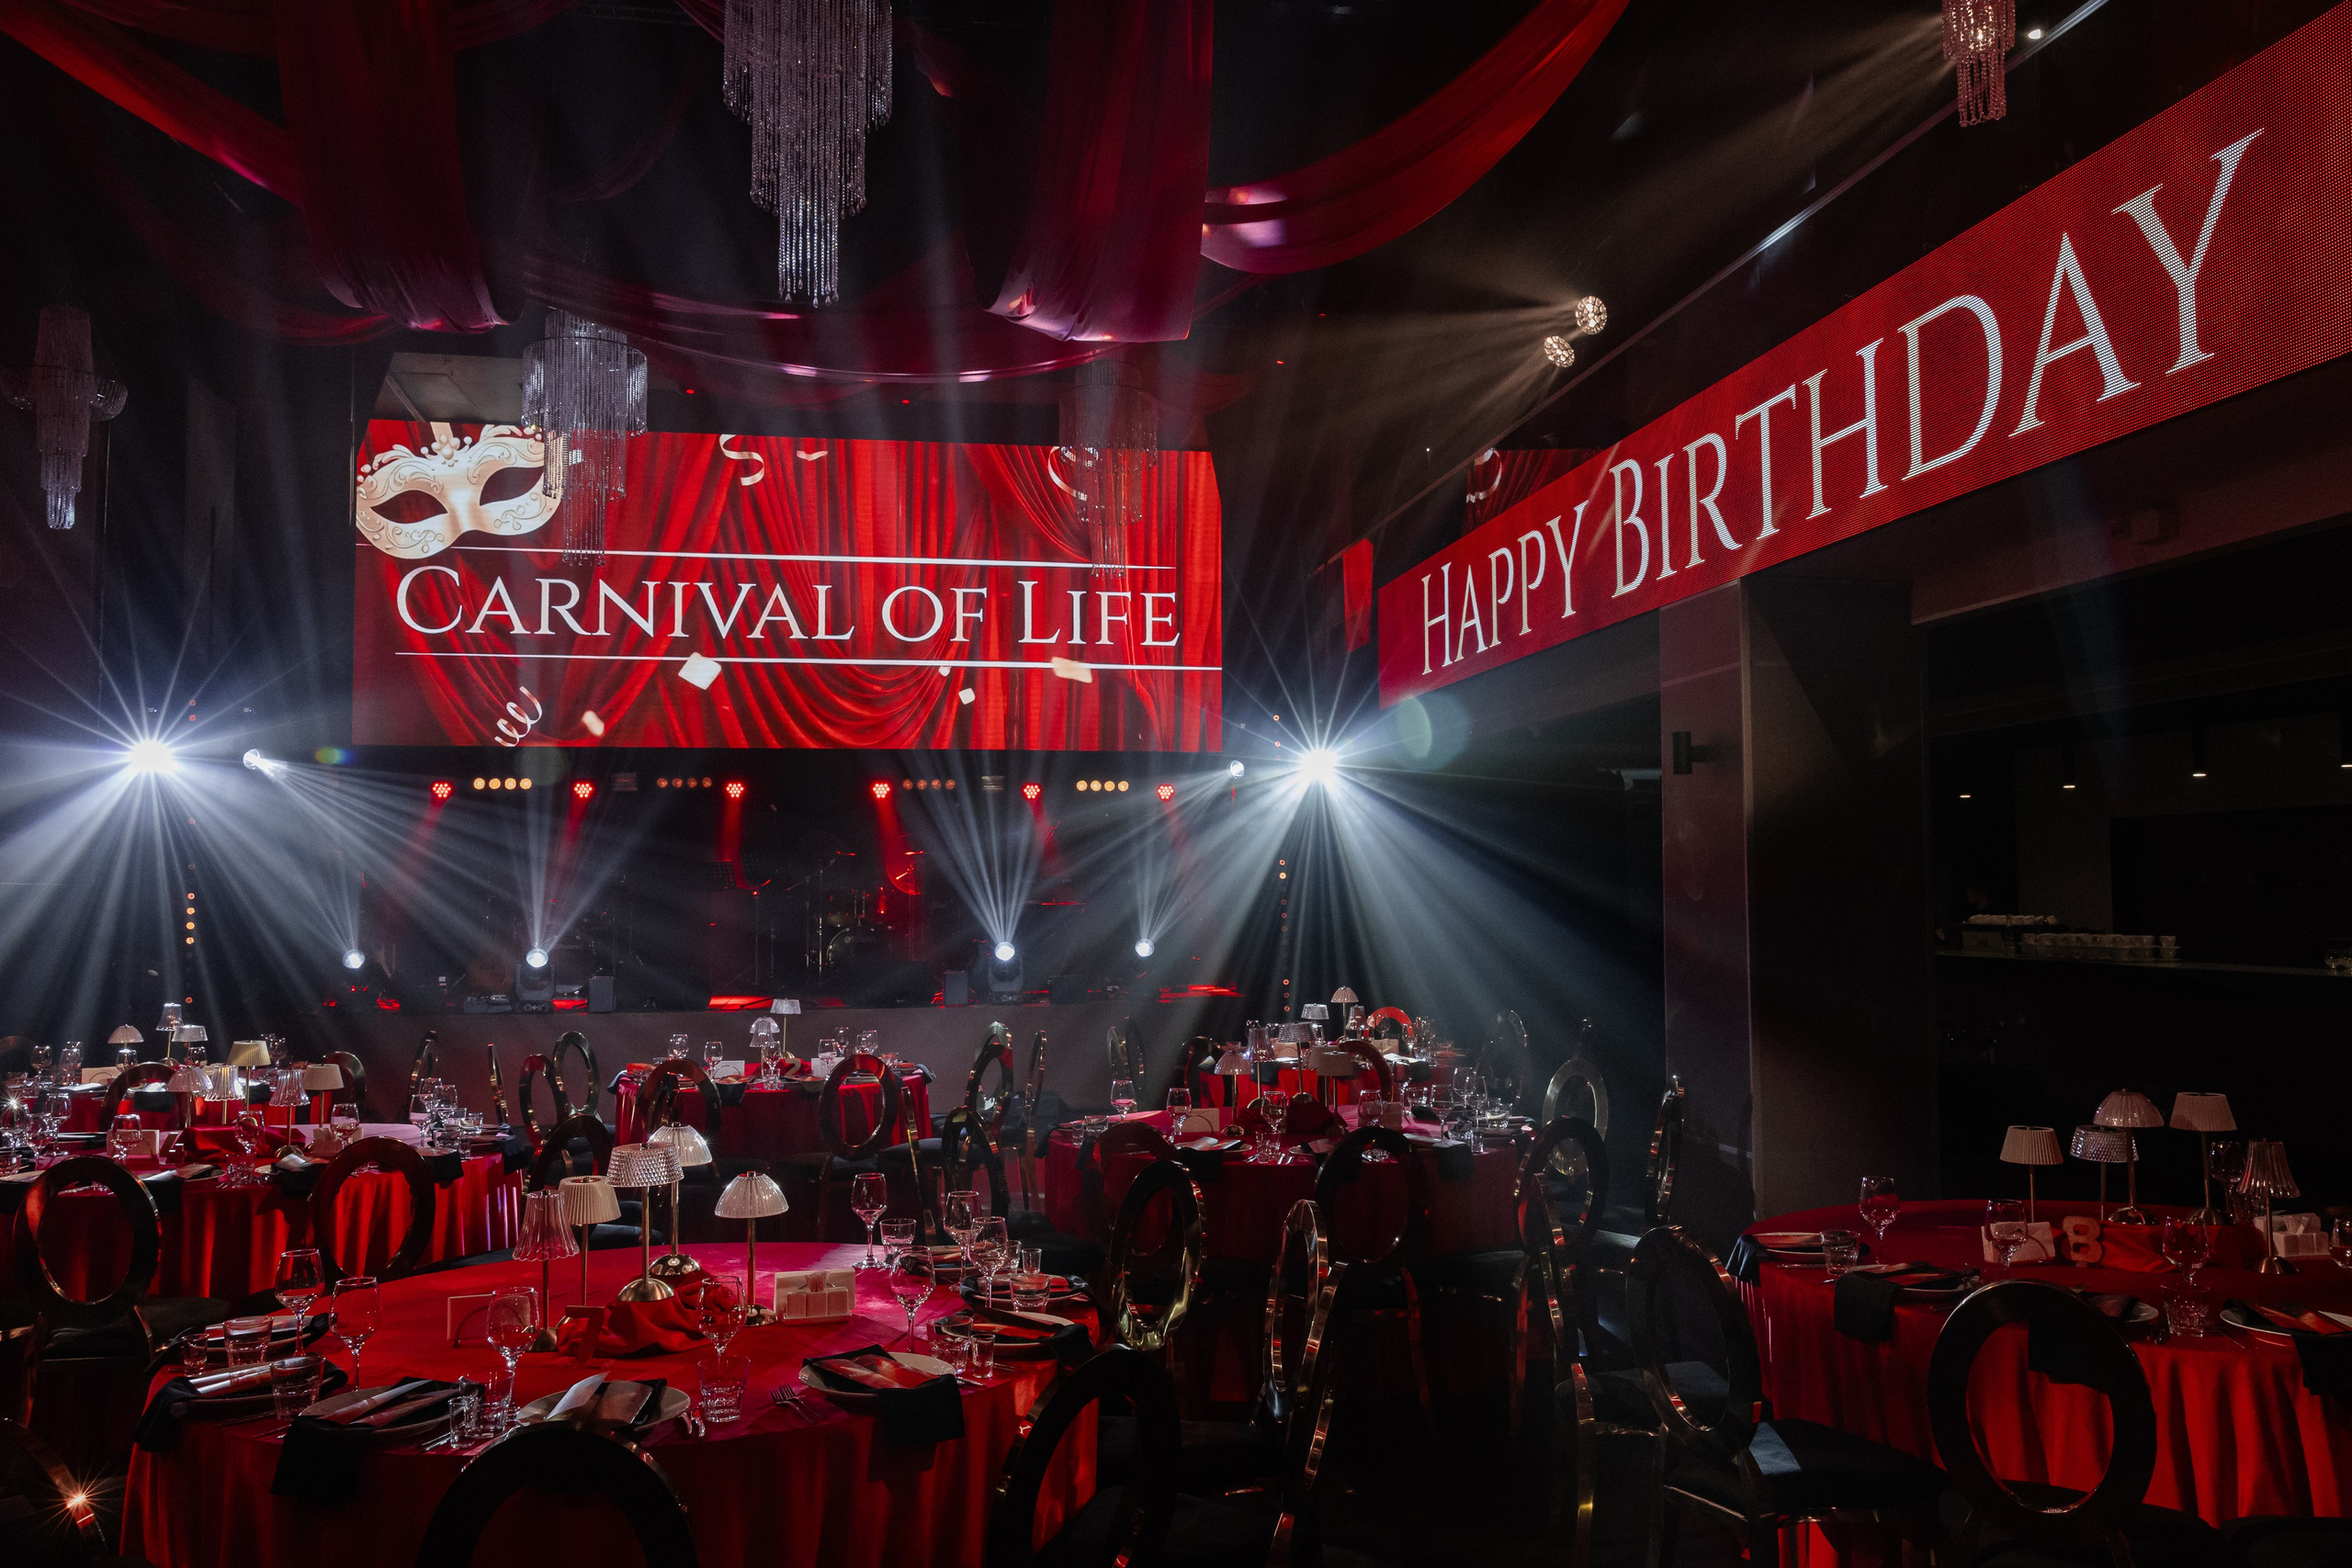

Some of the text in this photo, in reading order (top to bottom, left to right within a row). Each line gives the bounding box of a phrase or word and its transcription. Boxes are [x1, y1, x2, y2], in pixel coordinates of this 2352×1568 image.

[1420, 127, 2265, 676] HAPPY BIRTHDAY
[396, 565, 1182, 647] CARNIVAL OF LIFE
[785, 1057, 801, 1077] 2
[564, 1304, 605, 1363] 7
